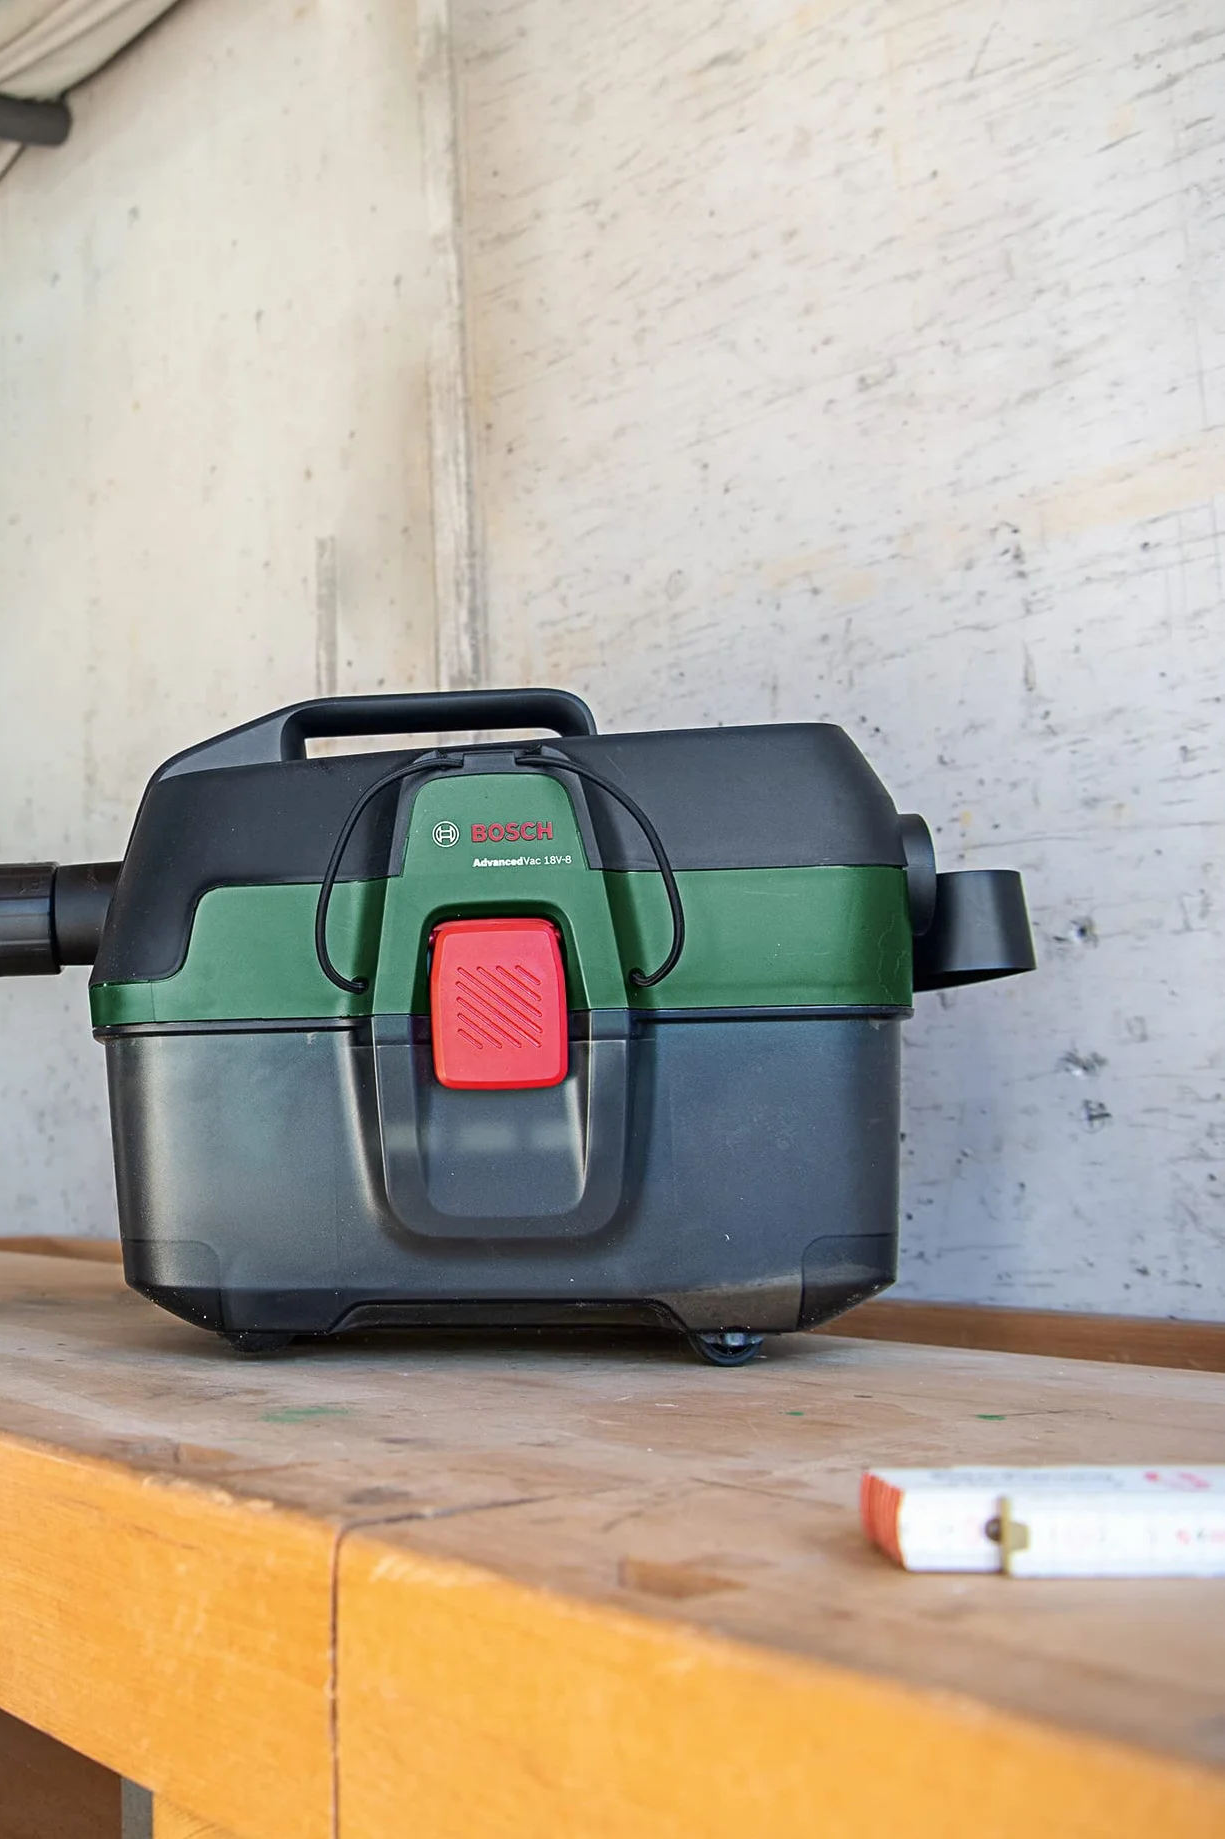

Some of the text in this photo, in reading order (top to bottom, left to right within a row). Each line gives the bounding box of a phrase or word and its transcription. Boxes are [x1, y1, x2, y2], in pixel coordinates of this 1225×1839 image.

[471, 821, 553, 843] BOSCH
[472, 855, 572, 868] AdvancedVac 18V-8
